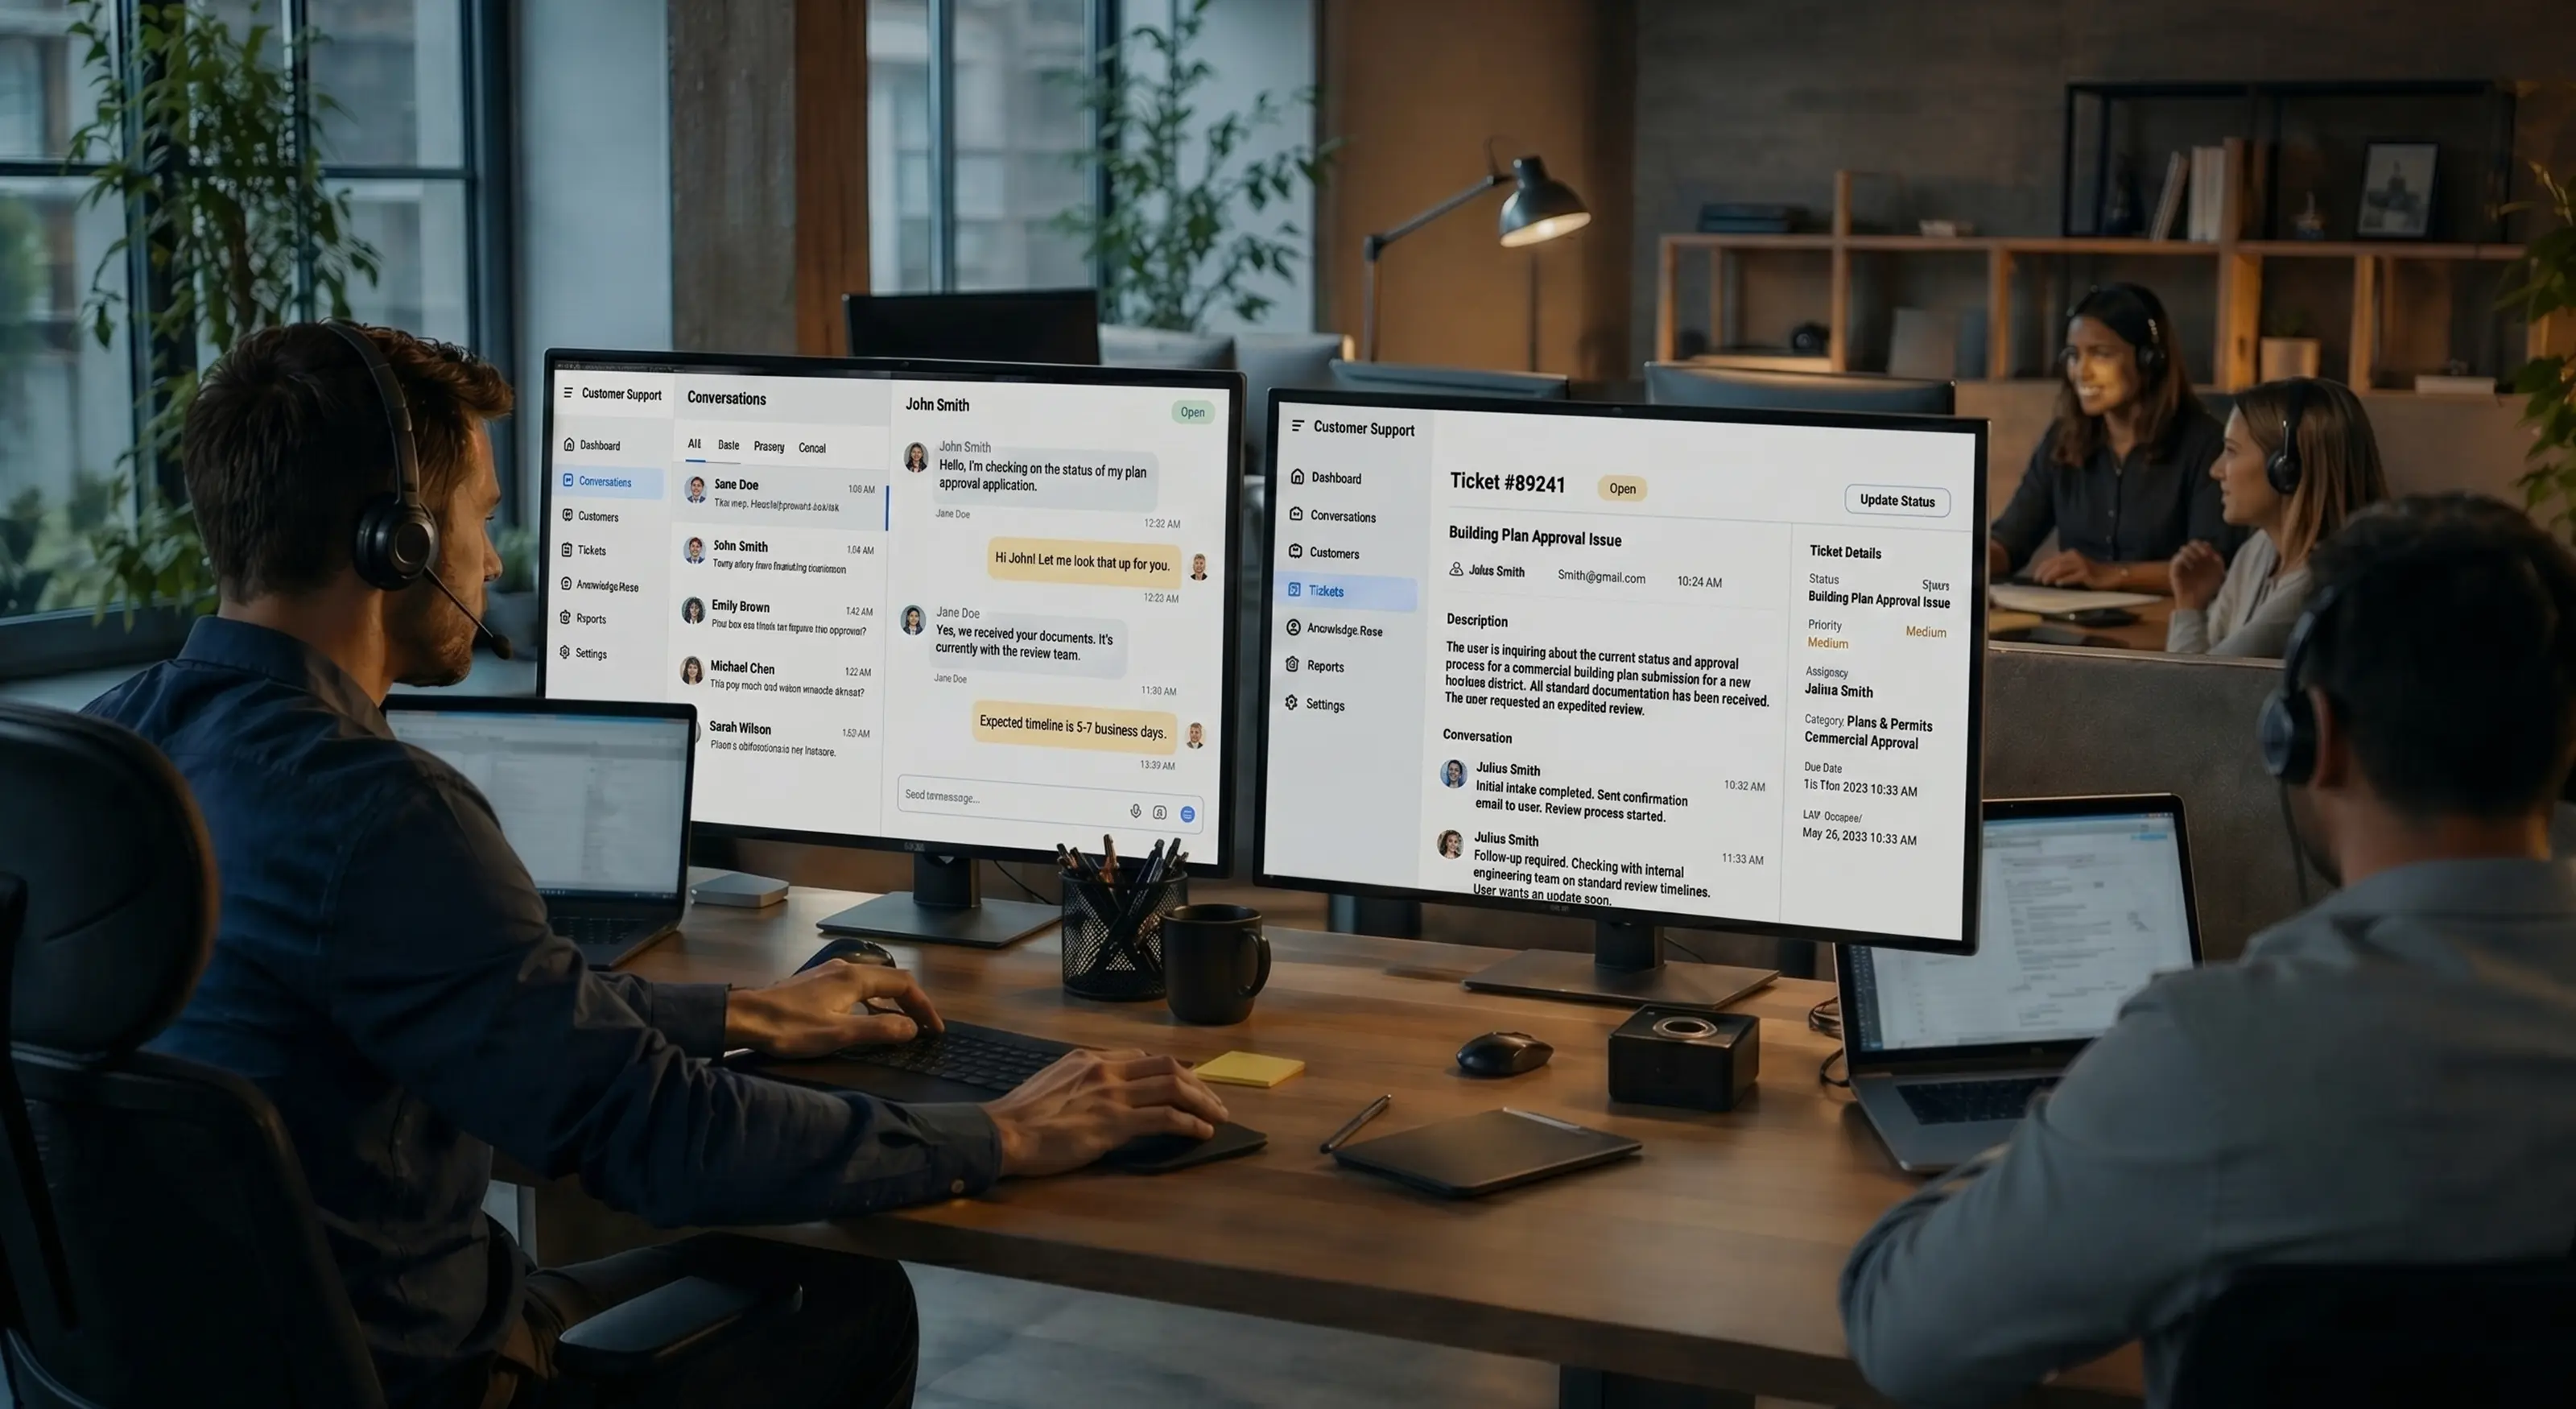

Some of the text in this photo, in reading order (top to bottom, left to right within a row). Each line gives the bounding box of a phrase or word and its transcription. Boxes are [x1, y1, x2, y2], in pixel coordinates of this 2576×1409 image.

[582, 387, 662, 403] Customer Support
[687, 390, 766, 405] Conversations
[906, 397, 969, 411] John Smith
[1180, 406, 1205, 419] Open
[1315, 419, 1415, 439] Customer Support
[580, 440, 620, 451] Dashboard
[939, 440, 991, 454] John Smith
[940, 459, 1146, 481] Hello, I'm checking on the status of my plan
[739, 479, 758, 490] Doe
[939, 477, 1037, 493] approval application.
[1312, 471, 1361, 485] Dashboard
[1451, 472, 1564, 493] Ticket #89241
[1609, 481, 1637, 497] Open
[1861, 494, 1935, 507] Update Status
[579, 510, 618, 523] Customers
[935, 509, 970, 519] Jane Doe
[1311, 510, 1376, 523] Conversations
[1167, 519, 1180, 528] AM
[1450, 525, 1622, 547] Building Plan Approval Issue
[578, 545, 606, 556] Tickets
[739, 540, 768, 552] Smith
[1810, 544, 1881, 560] Ticket Details
[1311, 547, 1360, 560] Customers
[996, 552, 1006, 563] Hi
[1038, 553, 1054, 565] Let
[1056, 557, 1071, 566] me
[1074, 555, 1095, 567] look
[1096, 556, 1117, 568] that
[1119, 560, 1131, 572] up
[1133, 557, 1148, 570] for
[1150, 561, 1170, 573] you.
[1496, 565, 1525, 577] Smith
[1558, 569, 1645, 584] Smith@gmail.com
[1678, 576, 1722, 588] 10:24 AM
[1810, 573, 1839, 586] Status
[1166, 594, 1179, 603] AM
[1809, 590, 1951, 609] Building Plan Approval Issue
[712, 599, 770, 614] Emily Brown
[937, 606, 980, 618] Jane Doe
[1447, 613, 1508, 630] Description
[1809, 619, 1842, 633] Priority
[936, 624, 1113, 645] Yes, we received your documents. It's
[1906, 626, 1946, 638] Medium
[1808, 636, 1848, 649] Medium
[576, 647, 607, 661] Settings
[936, 643, 1080, 660] currently with the review team.
[1447, 641, 1739, 670] The user is inquiring about the current status and approval
[711, 660, 774, 675] Michael Chen
[1308, 659, 1344, 673] Reports
[934, 674, 967, 684] Jane Doe
[1164, 687, 1176, 696] AM
[1841, 685, 1873, 698] Smith
[1307, 698, 1345, 713] Settings
[709, 721, 771, 735] Sarah Wilson
[980, 714, 1167, 742] Expected timeline is 5-7 business days.
[1847, 715, 1933, 732] Plans & Permits
[1443, 729, 1512, 744] Conversation
[1871, 735, 1918, 750] Approval
[1162, 762, 1175, 770] AM
[1476, 762, 1540, 776] Julius Smith
[1805, 762, 1842, 773] Due Date
[1725, 780, 1765, 791] 10:32 AM
[1843, 782, 1918, 797] 2023 10:33 AM
[1476, 780, 1687, 806] Initial intake completed. Sent confirmation
[1475, 832, 1538, 847] Julius Smith
[1803, 827, 1917, 845] May 26, 2033 10:33 AM
[1475, 849, 1684, 878] Follow-up required. Checking with internal
[1723, 853, 1764, 865] 11:33 AM
